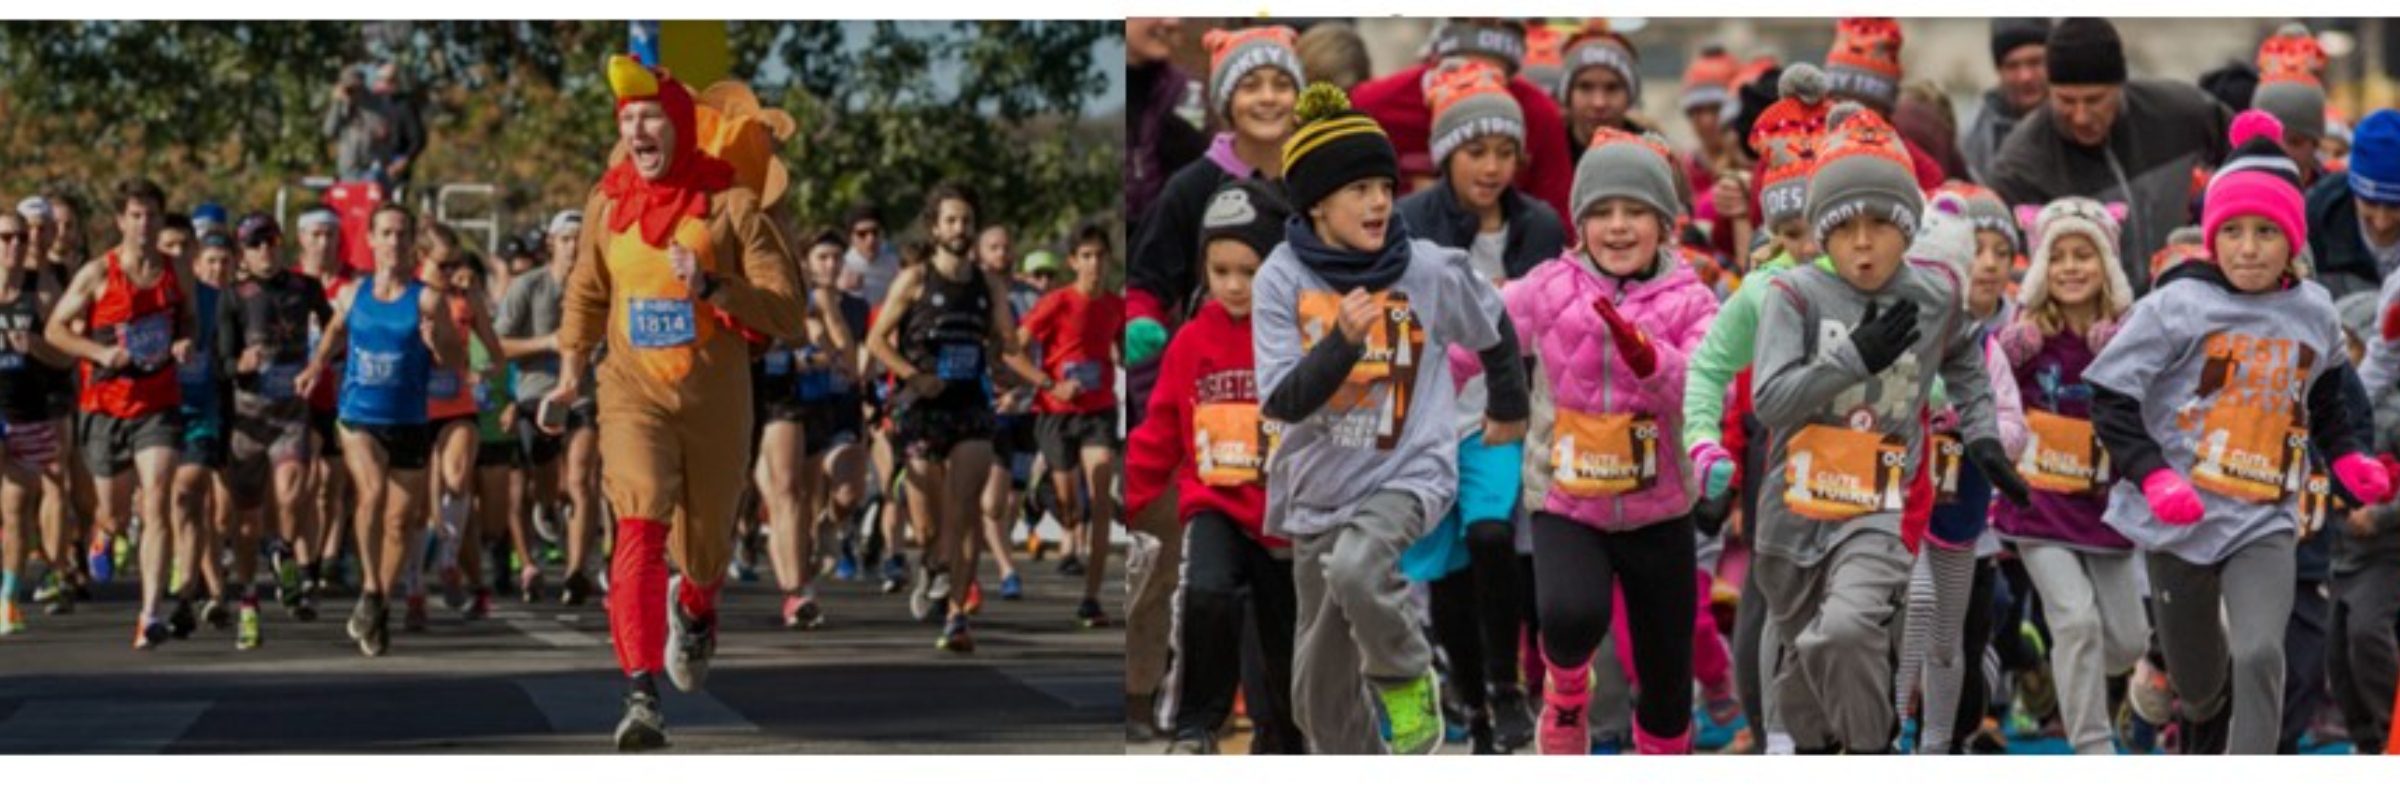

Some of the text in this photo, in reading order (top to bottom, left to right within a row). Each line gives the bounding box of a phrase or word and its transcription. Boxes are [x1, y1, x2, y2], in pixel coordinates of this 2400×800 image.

[2207, 333, 2293, 364] BEST
[1553, 433, 1578, 482] 1
[2197, 429, 2230, 475] 1
[1787, 451, 1814, 502] 1
[1814, 482, 1882, 508] TURKEY
[1817, 470, 1861, 488] CUTE
